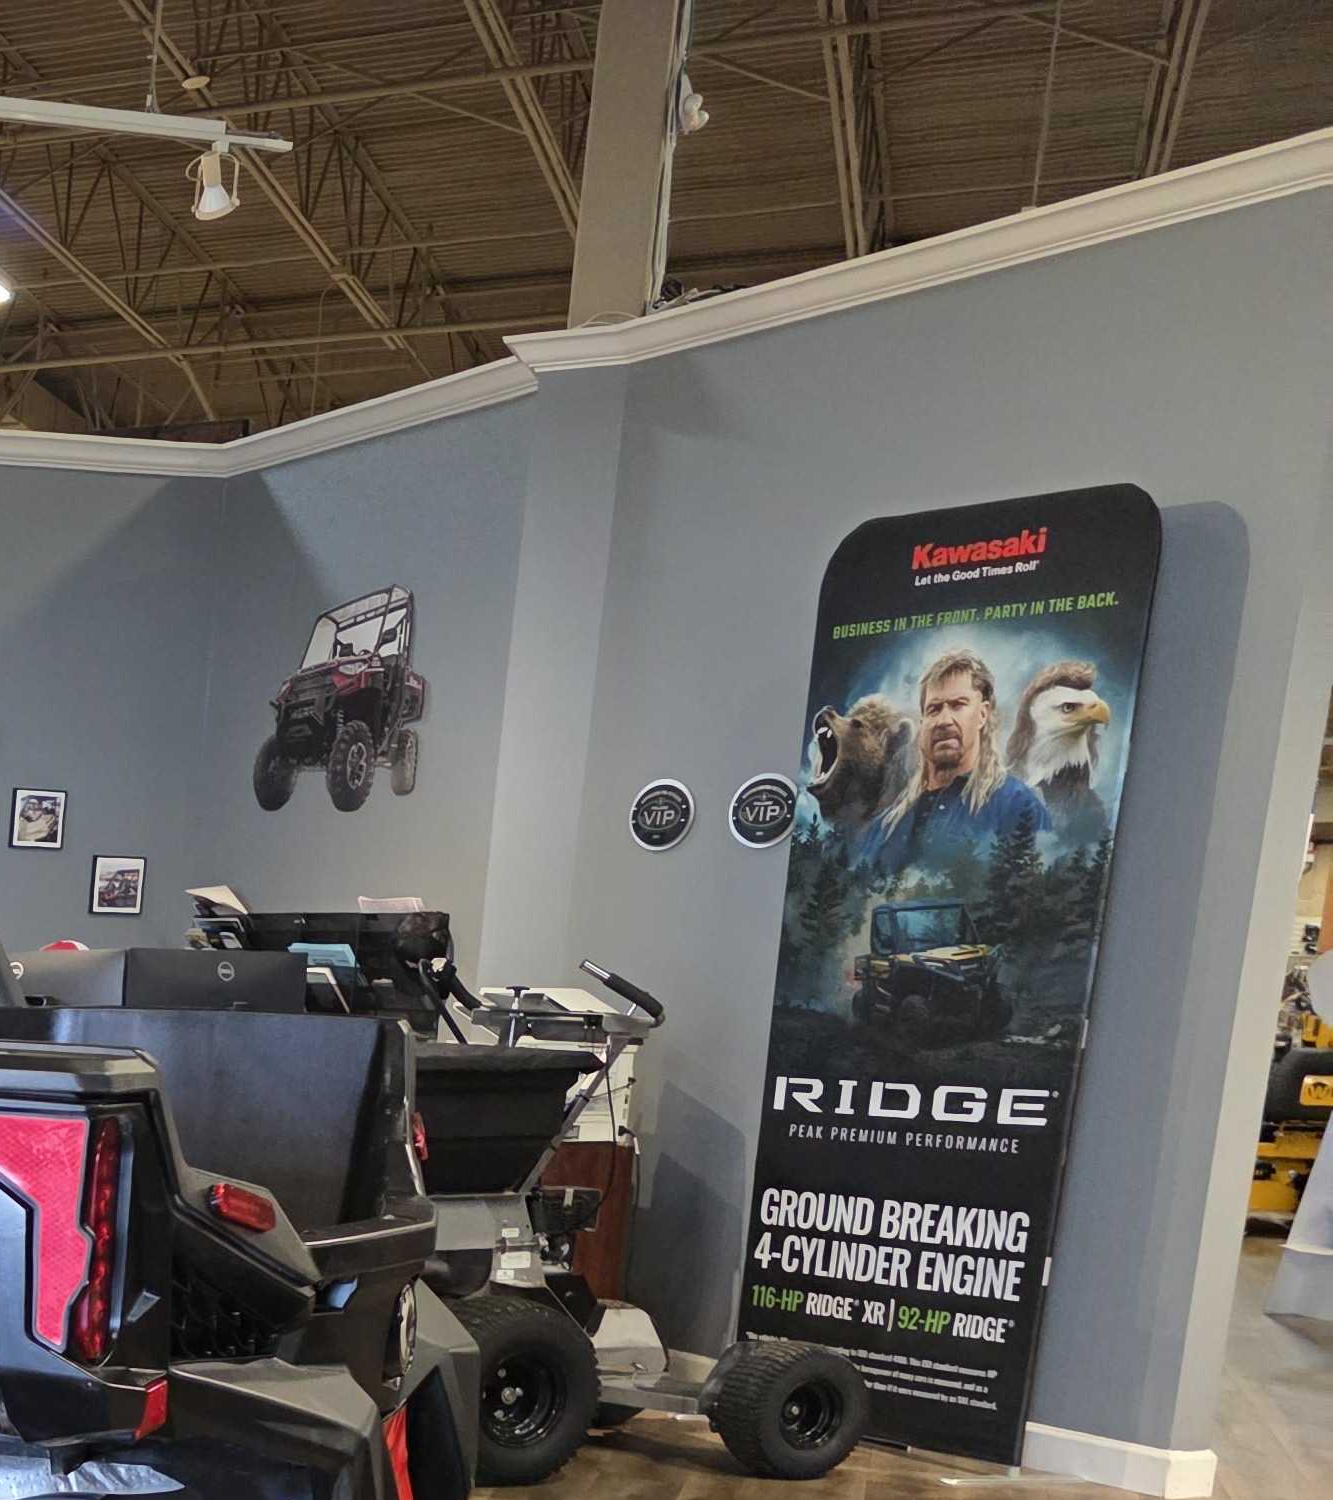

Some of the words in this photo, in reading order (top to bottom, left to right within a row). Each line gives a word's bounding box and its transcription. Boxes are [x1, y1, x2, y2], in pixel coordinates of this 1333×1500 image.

[911, 527, 1049, 570] Kawasaki
[915, 575, 932, 586] Let
[934, 572, 950, 584] the
[952, 567, 980, 582] Good
[982, 563, 1013, 579] Times
[833, 620, 891, 640] BUSINESS
[894, 617, 908, 630] IN
[909, 613, 934, 629] THE
[936, 607, 980, 625] FRONT.
[984, 602, 1028, 620] PARTY
[1030, 600, 1045, 614] IN
[1048, 596, 1074, 613] THE
[1076, 591, 1119, 608] BACK.
[643, 809, 675, 825] VIP
[745, 805, 780, 822] VIP
[773, 1076, 1051, 1126] RIDGE
[789, 1123, 823, 1139] PEAK
[830, 1126, 898, 1145] PREMIUM
[905, 1132, 1019, 1154] PERFORMANCE
[760, 1187, 875, 1236] GROUND
[879, 1200, 1030, 1253] BREAKING
[753, 1232, 912, 1288] 4-CYLINDER
[917, 1251, 1025, 1302] ENGINE
[751, 1284, 805, 1312] 116-HP
[806, 1292, 855, 1321] RIDGE
[861, 1299, 886, 1325] XR
[898, 1305, 951, 1335] 92-HP
[952, 1313, 1010, 1344] RIDGE
